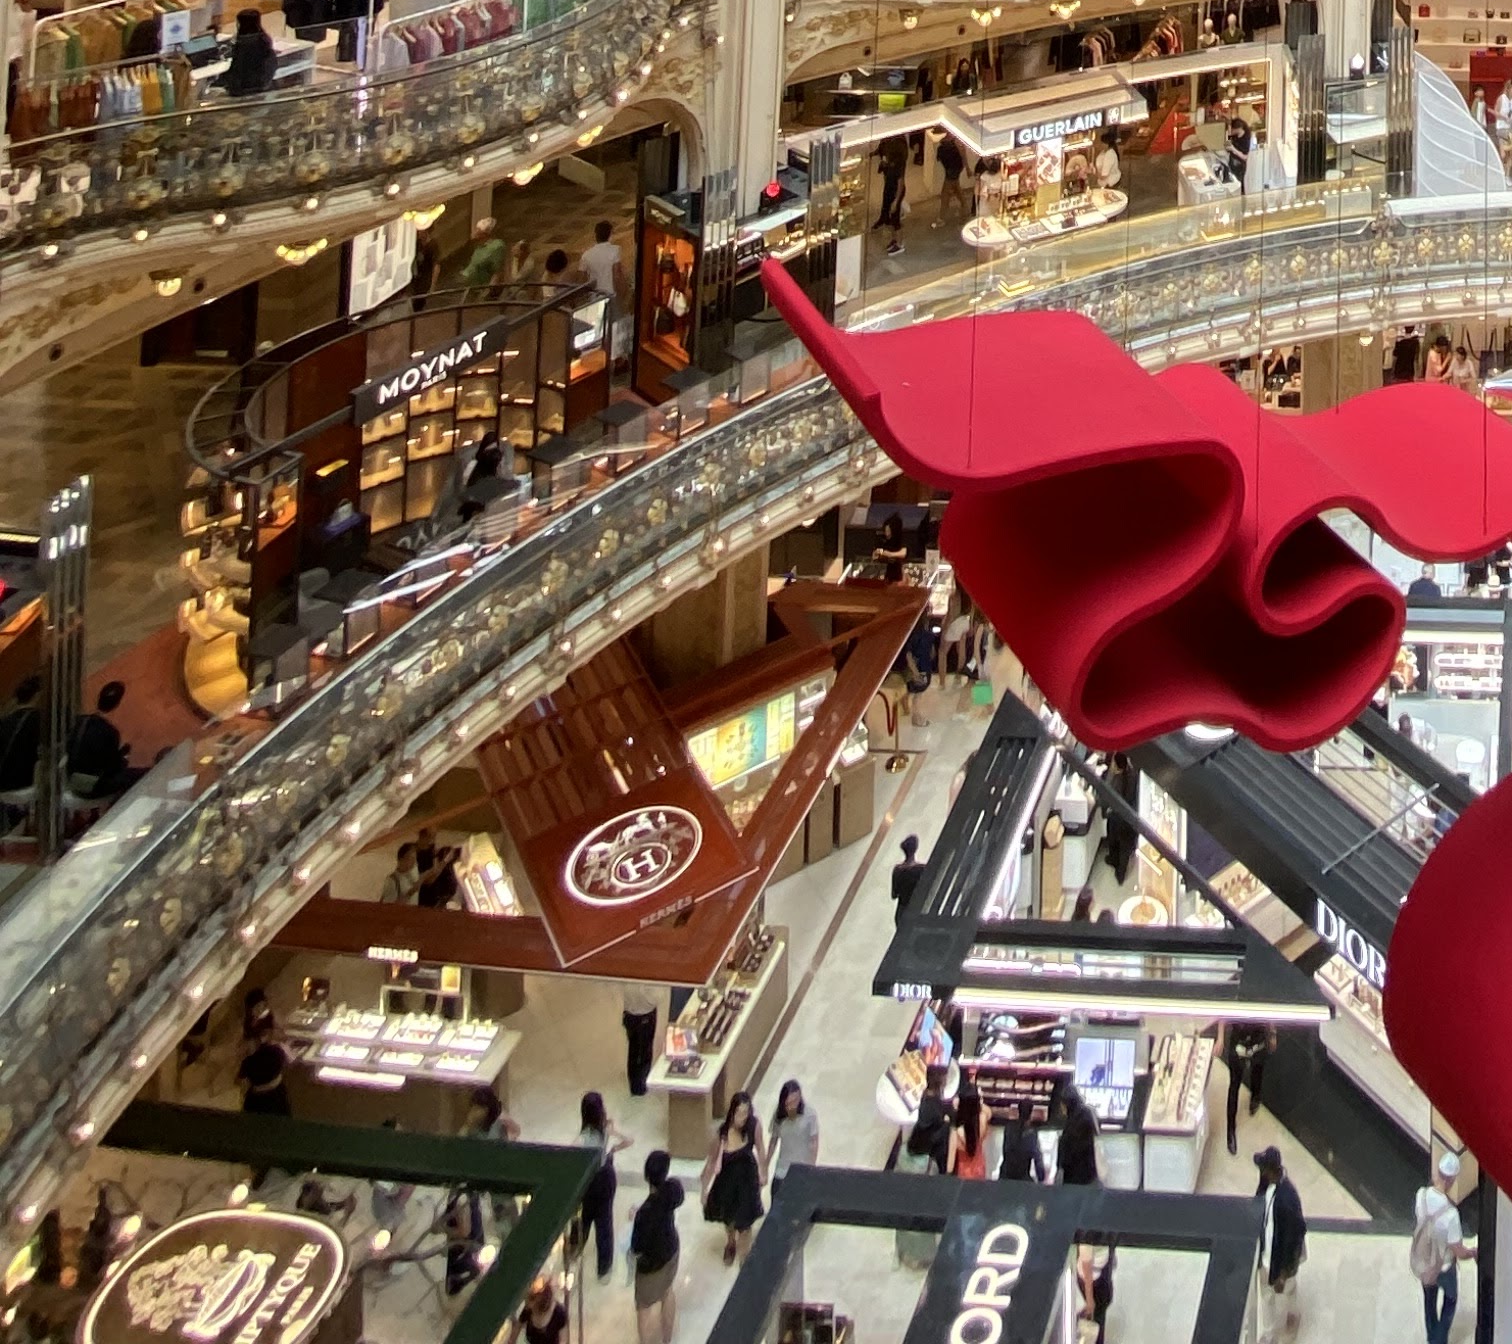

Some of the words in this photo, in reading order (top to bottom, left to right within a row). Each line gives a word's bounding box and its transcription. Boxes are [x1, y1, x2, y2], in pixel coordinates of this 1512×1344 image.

[1019, 112, 1103, 144] GUERLAIN
[378, 331, 487, 404] MOYNAT
[1316, 898, 1387, 989] DIOR
[893, 982, 932, 1000] DIOR
[950, 1223, 1029, 1344] ORD
